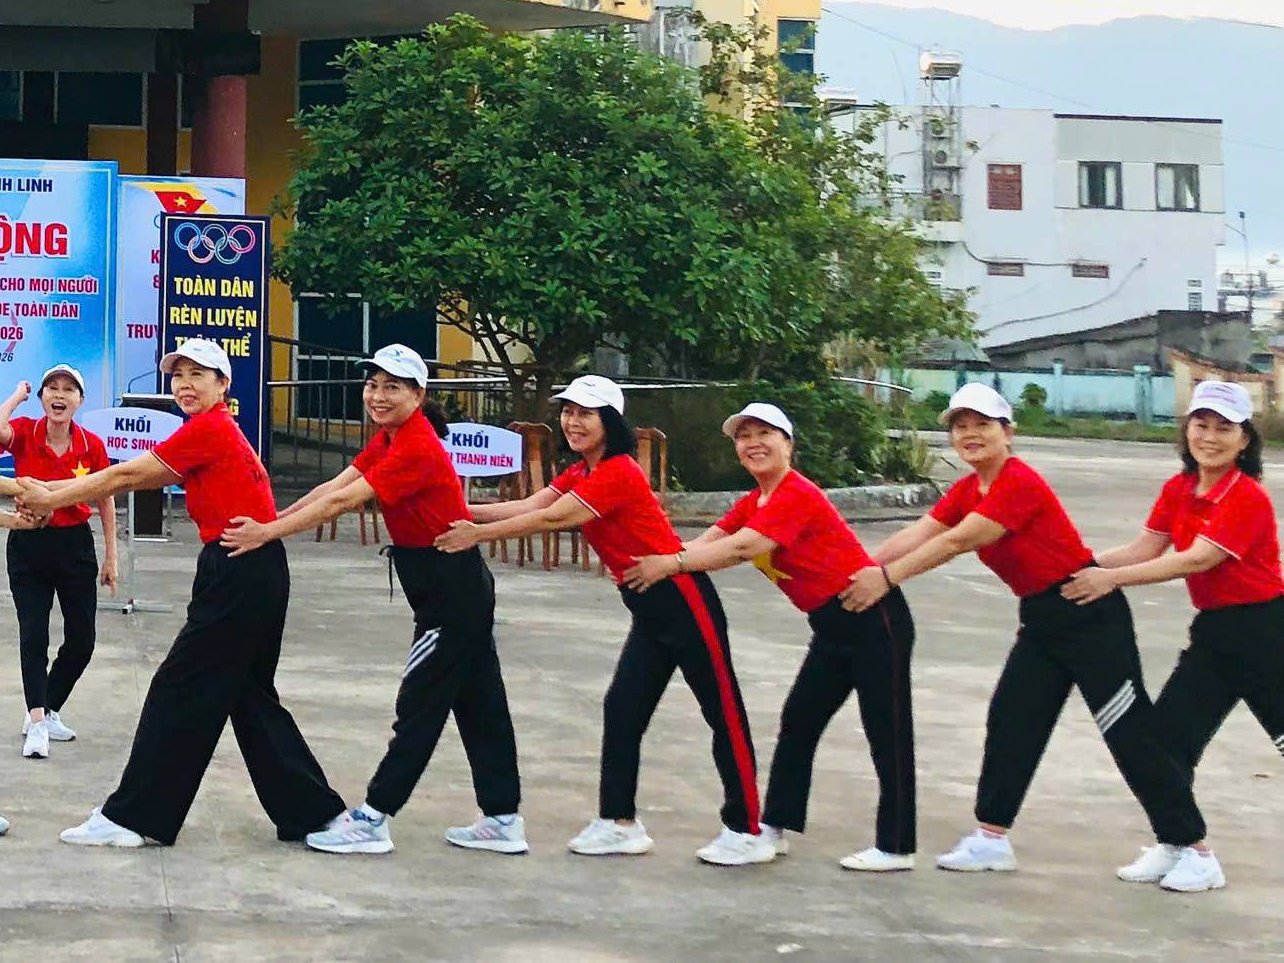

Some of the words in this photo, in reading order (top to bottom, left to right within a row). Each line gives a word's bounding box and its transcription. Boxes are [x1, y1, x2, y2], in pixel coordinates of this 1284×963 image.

[17, 178, 53, 193] LINH
[0, 277, 25, 291] CHO
[29, 278, 54, 295] MỌI
[58, 276, 98, 294] NGƯỜI
[173, 274, 216, 296] TOÀN
[220, 276, 254, 298] DÂN
[15, 300, 48, 317] TOÀN
[51, 302, 79, 318] DÂN
[169, 303, 203, 326] RÈN
[206, 305, 257, 331] LUYỆN
[220, 332, 252, 357] THỂ
[114, 414, 151, 433] KHỐI
[107, 436, 128, 450] HỌC
[451, 430, 489, 449] KHỐI
[456, 452, 487, 466] THANH
[489, 453, 513, 467] NIÊN
